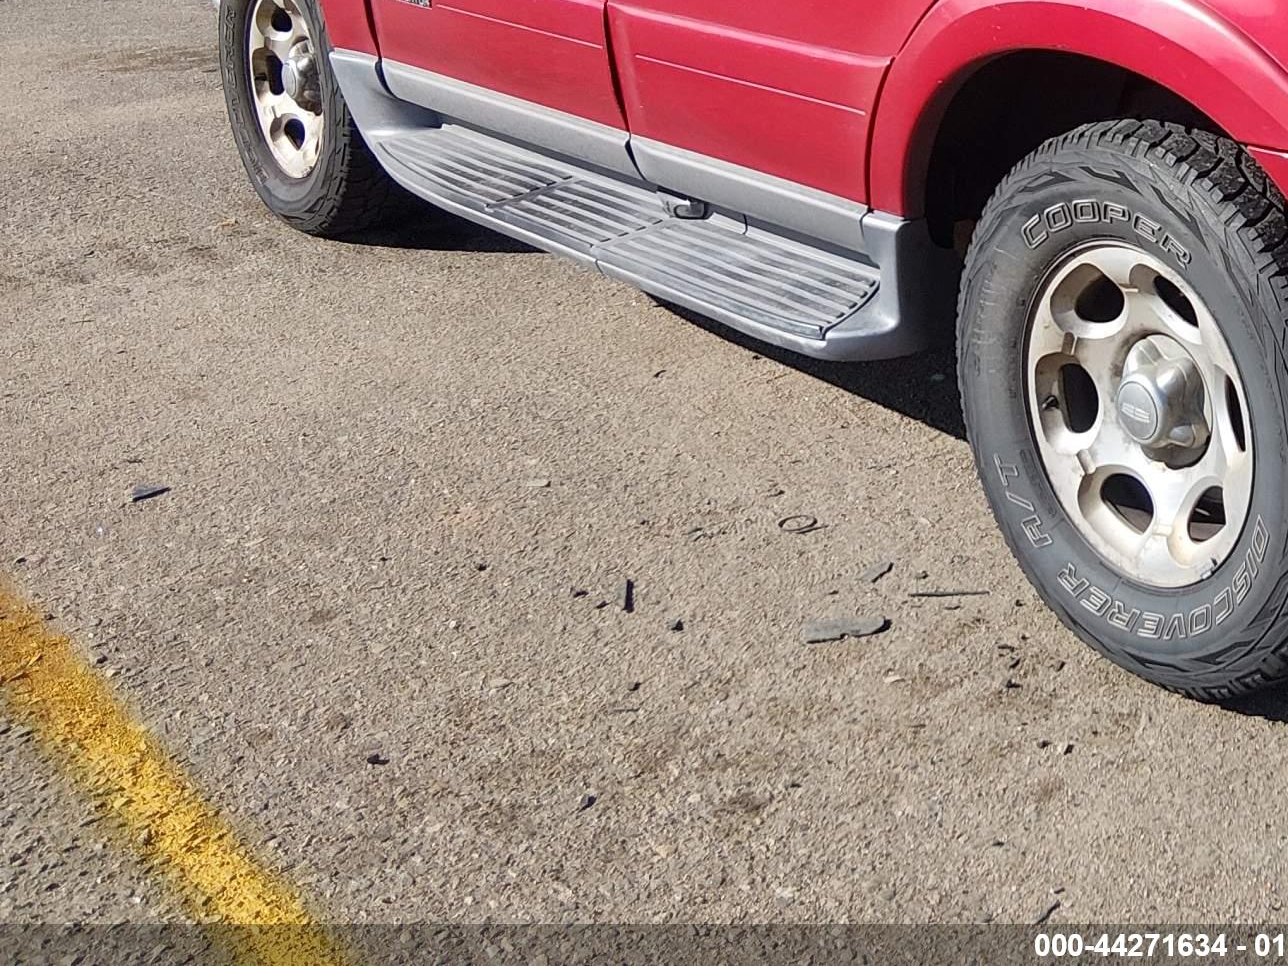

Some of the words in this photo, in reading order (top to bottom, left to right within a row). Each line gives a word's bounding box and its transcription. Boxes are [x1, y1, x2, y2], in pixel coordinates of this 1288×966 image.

[1021, 199, 1192, 270] COOPER
[994, 454, 1053, 548] A/T
[1056, 514, 1270, 641] DISCOVERER
